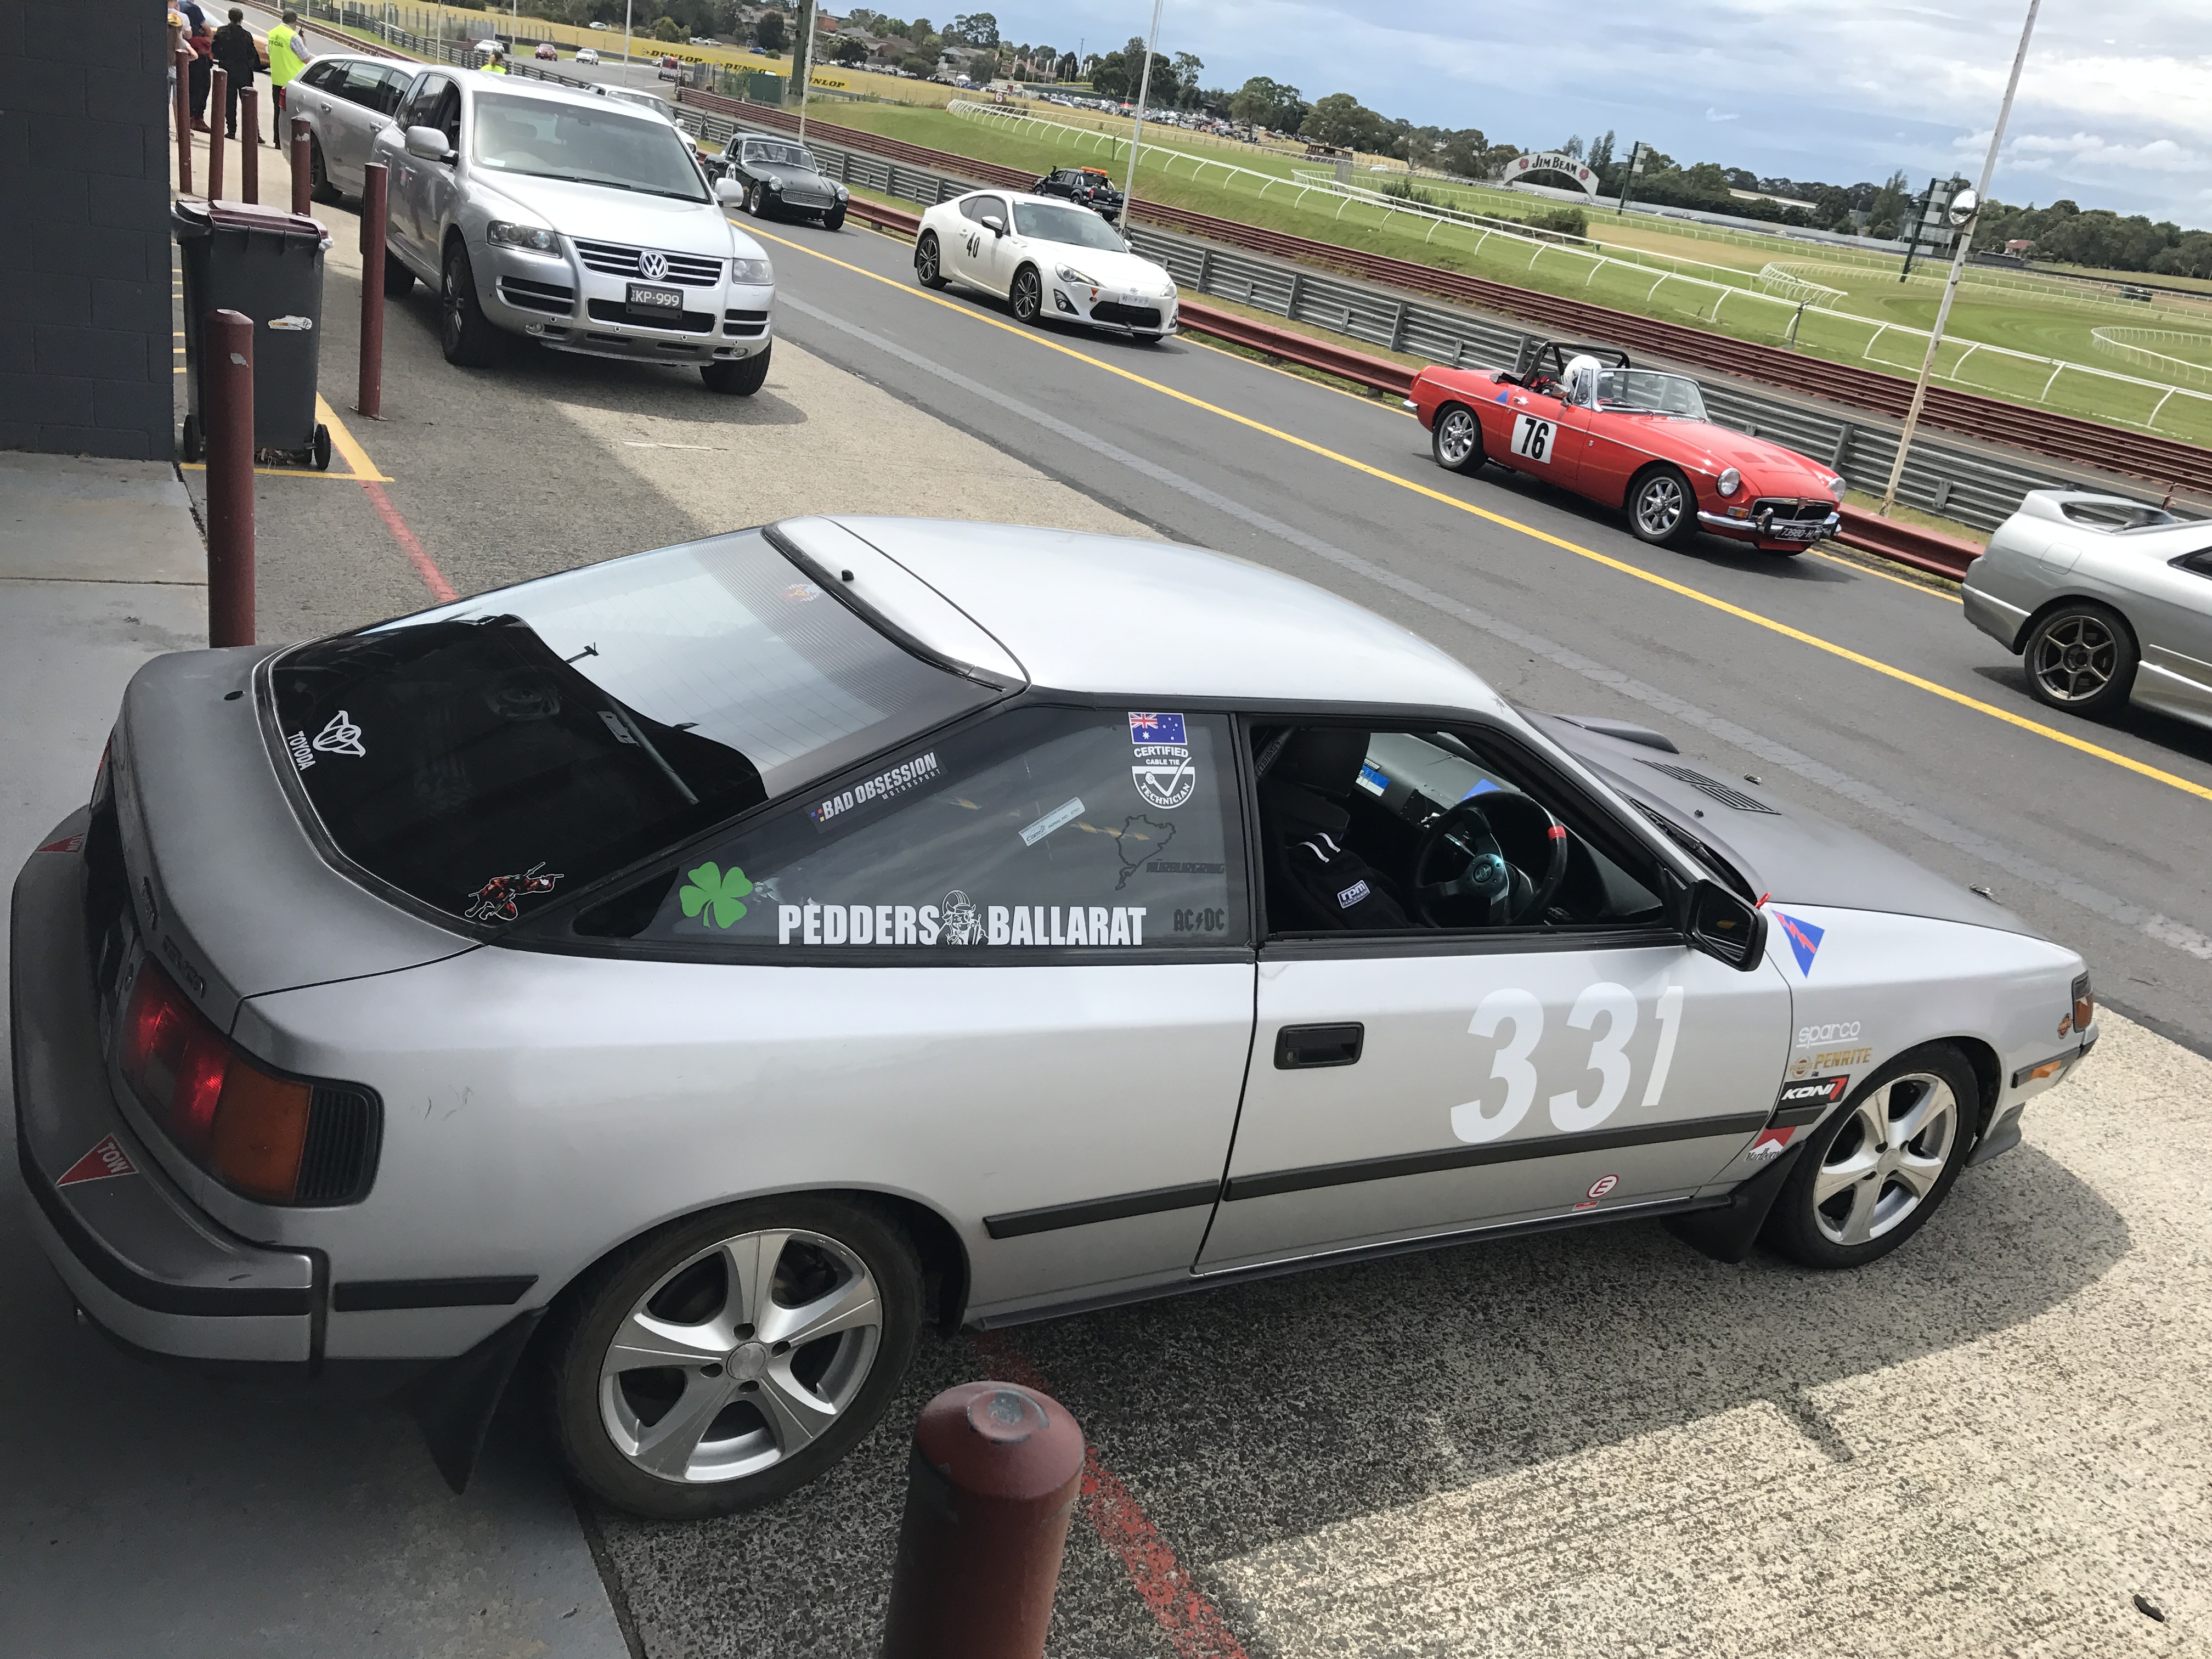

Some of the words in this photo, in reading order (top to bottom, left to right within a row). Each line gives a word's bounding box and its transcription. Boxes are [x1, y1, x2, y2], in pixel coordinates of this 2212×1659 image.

[995, 92, 1003, 103] 6
[1532, 155, 1551, 168] JIM
[1553, 156, 1577, 175] BEAM
[967, 232, 980, 258] 40
[1521, 417, 1549, 459] 76
[287, 730, 316, 771] TOYODA
[1133, 746, 1188, 758] CERTIFIED
[822, 791, 854, 820] BAD
[855, 752, 937, 804] OBSESSION
[882, 769, 940, 799] MOTORSPORT
[1141, 782, 1190, 805] TECHNICIAN
[1048, 819, 1062, 828] SERIAL
[1341, 883, 1365, 901] rpm
[778, 905, 939, 945] PEDDERS
[988, 906, 1147, 945] BALLARAT
[1798, 1021, 1860, 1048] sparco
[1451, 982, 1684, 1143] 331
[1814, 1047, 1872, 1069] PENRITE
[97, 1142, 129, 1173] TOW
